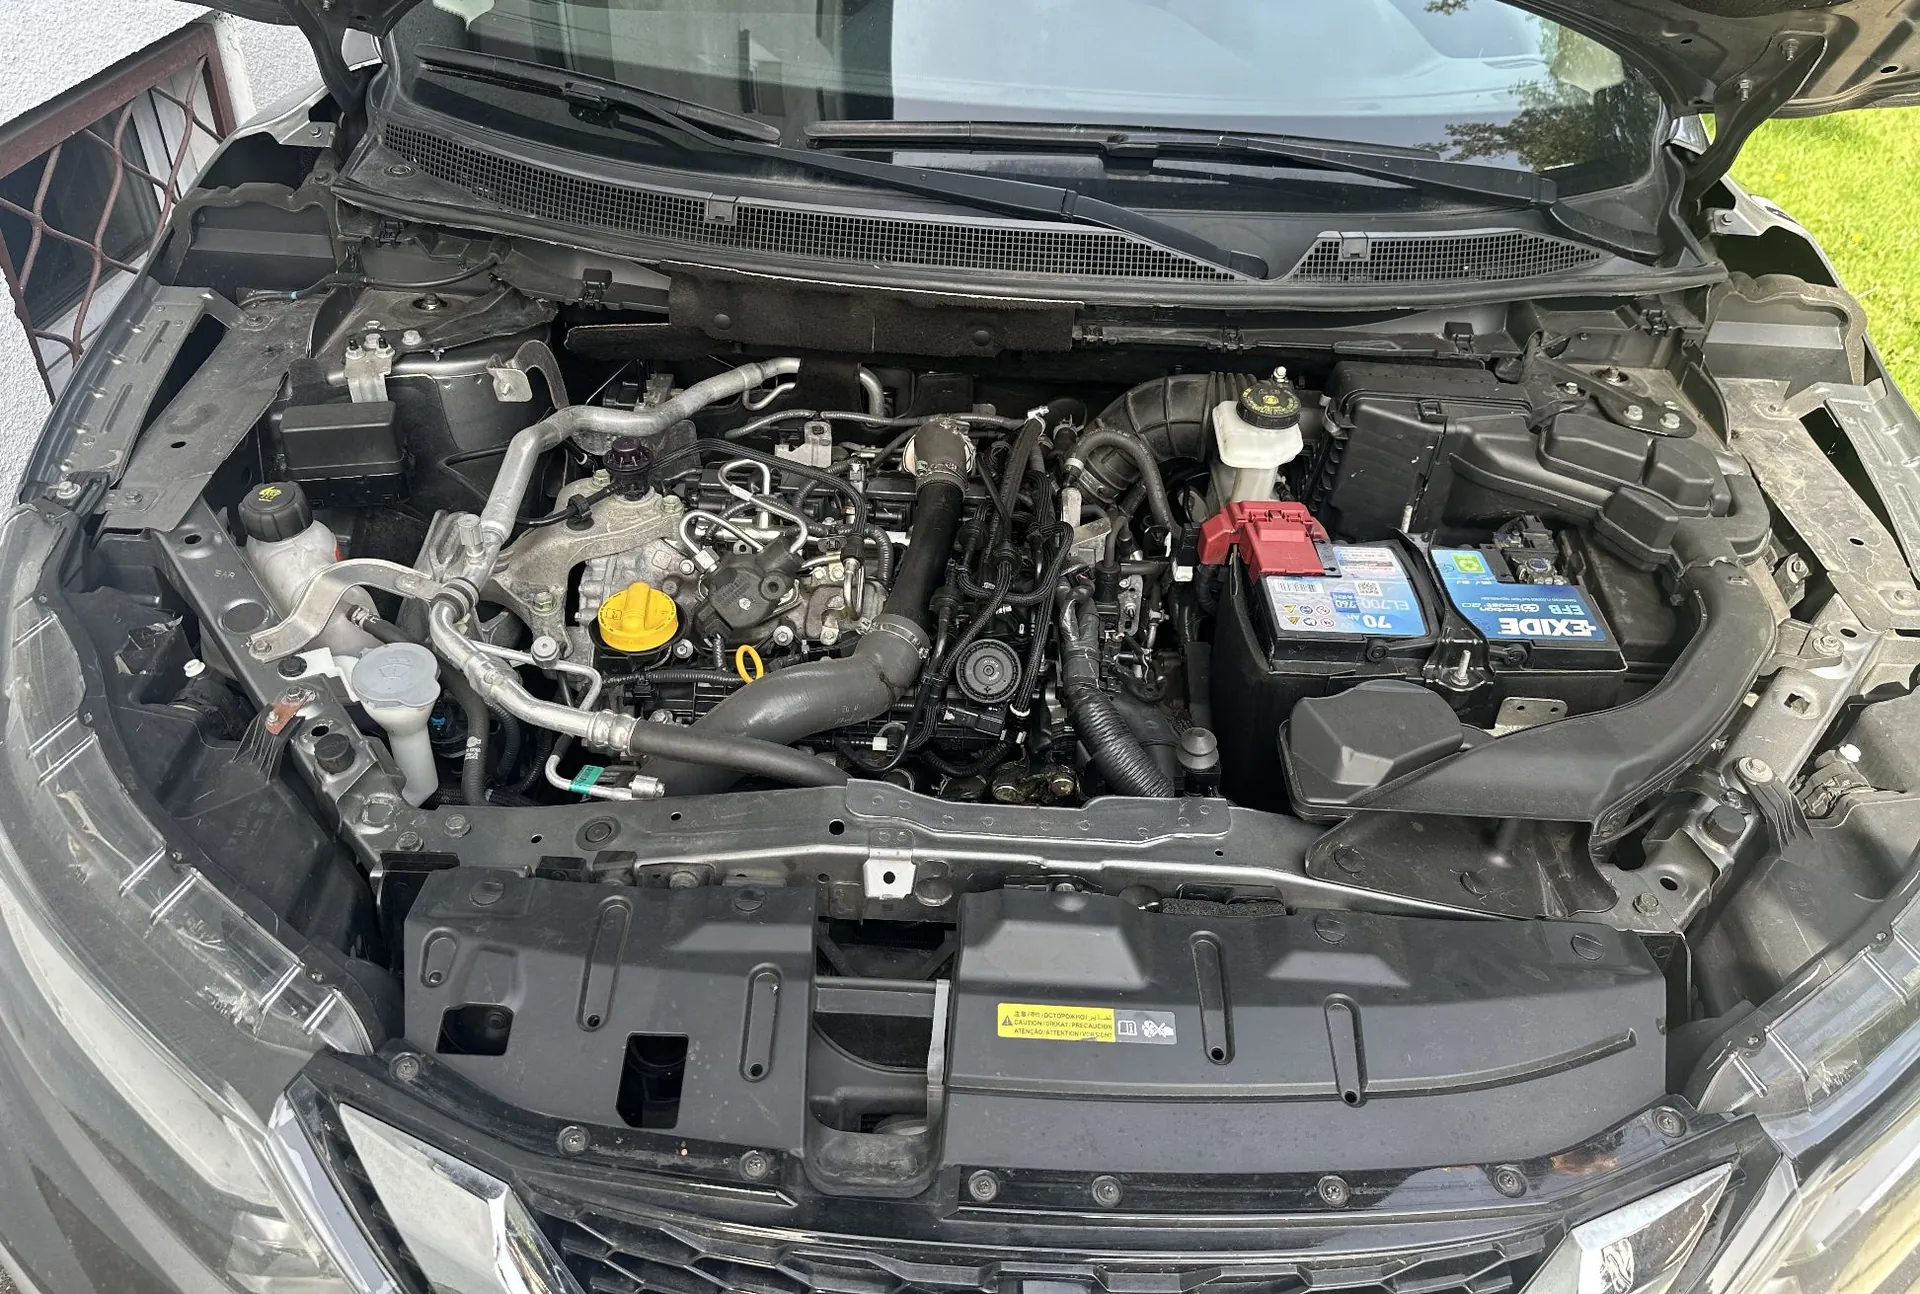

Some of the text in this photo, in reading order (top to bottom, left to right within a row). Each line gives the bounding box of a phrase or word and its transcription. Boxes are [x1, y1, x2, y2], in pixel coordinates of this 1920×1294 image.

[1335, 600, 1357, 609] 760
[1548, 604, 1585, 616] EFB
[1362, 614, 1392, 629] 70
[1498, 618, 1597, 637] EXIDE
